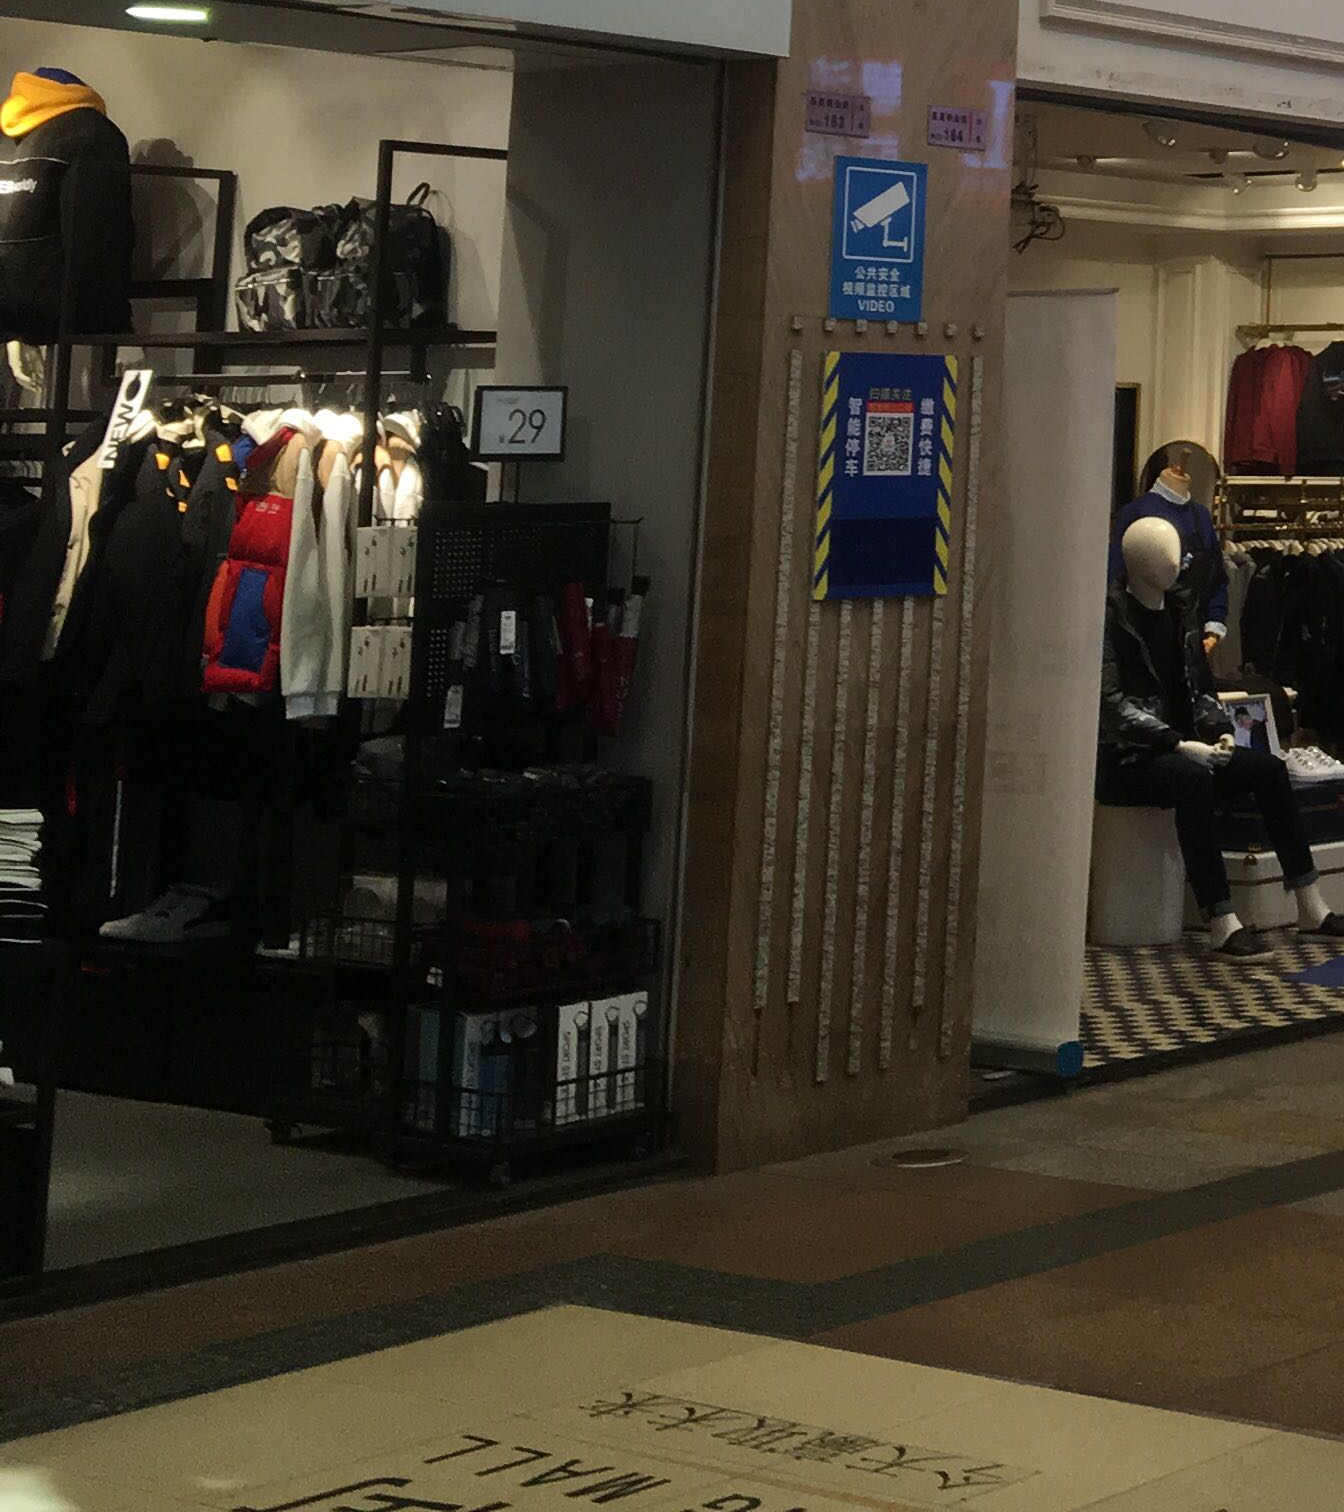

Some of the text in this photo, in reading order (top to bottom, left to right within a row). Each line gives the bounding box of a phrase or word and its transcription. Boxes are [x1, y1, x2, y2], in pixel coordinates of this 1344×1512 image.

[854, 266, 900, 282] 公共安全
[857, 299, 896, 313] VIDEO
[845, 396, 863, 478] 智能停车
[422, 1434, 672, 1505] MALL
